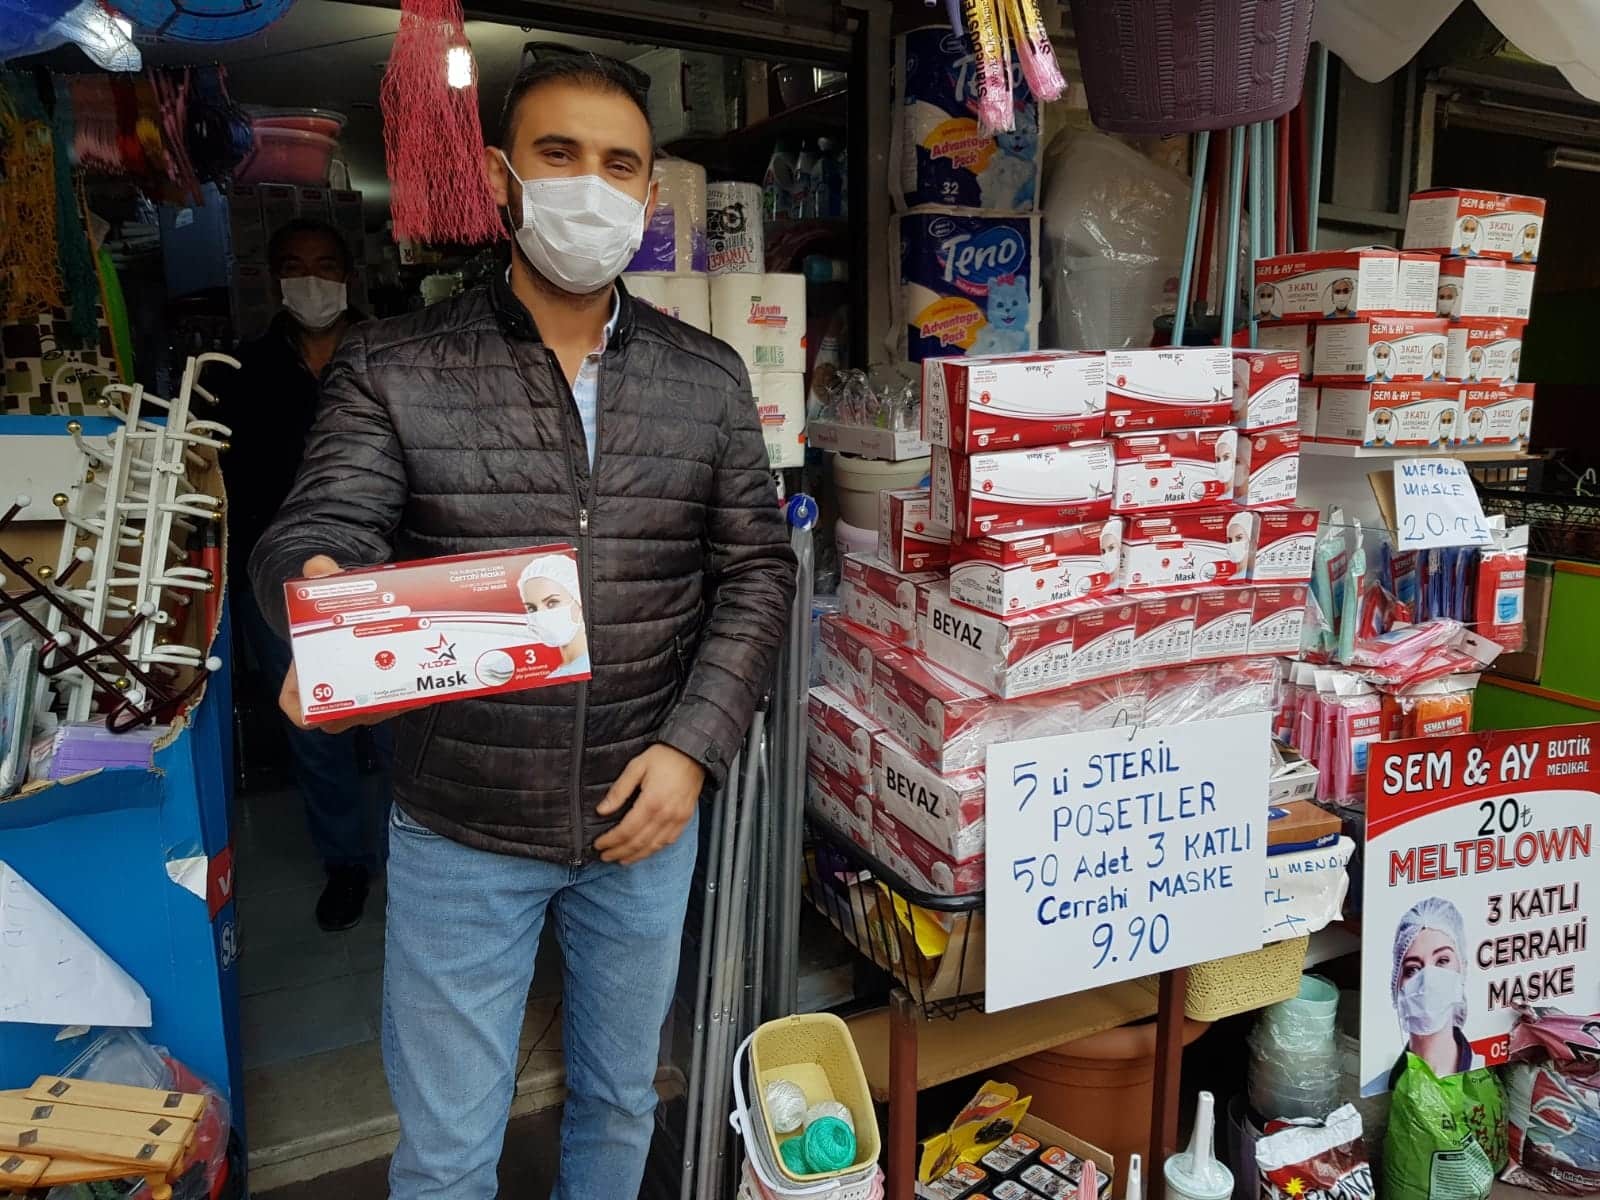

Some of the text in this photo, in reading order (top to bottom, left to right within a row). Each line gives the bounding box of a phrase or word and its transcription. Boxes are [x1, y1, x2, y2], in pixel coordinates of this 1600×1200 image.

[942, 182, 960, 195] 32
[942, 234, 1018, 282] Teno
[920, 311, 980, 338] Advantage
[941, 329, 967, 347] Pack
[933, 608, 984, 651] BEYAZ
[525, 648, 537, 664] 3
[315, 687, 331, 698] 50
[416, 671, 468, 692] Mask
[1383, 741, 1540, 795] SEM & AY
[1546, 761, 1590, 777] MEDİKAL
[1547, 737, 1591, 759] BUTİK
[887, 767, 941, 818] BEYAZ
[1013, 761, 1037, 812] 5
[1054, 781, 1216, 841] POŞETLER
[1013, 823, 1251, 893] 50 Adet 3 KATLI
[1388, 824, 1592, 888] MELTBLOWN
[1037, 865, 1233, 926] Cerrahi MASKE
[1487, 882, 1580, 925] 3 KATLI
[1092, 913, 1169, 969] 9.90
[1476, 916, 1588, 970] CERRAHİ
[1488, 966, 1576, 1012] MASKE
